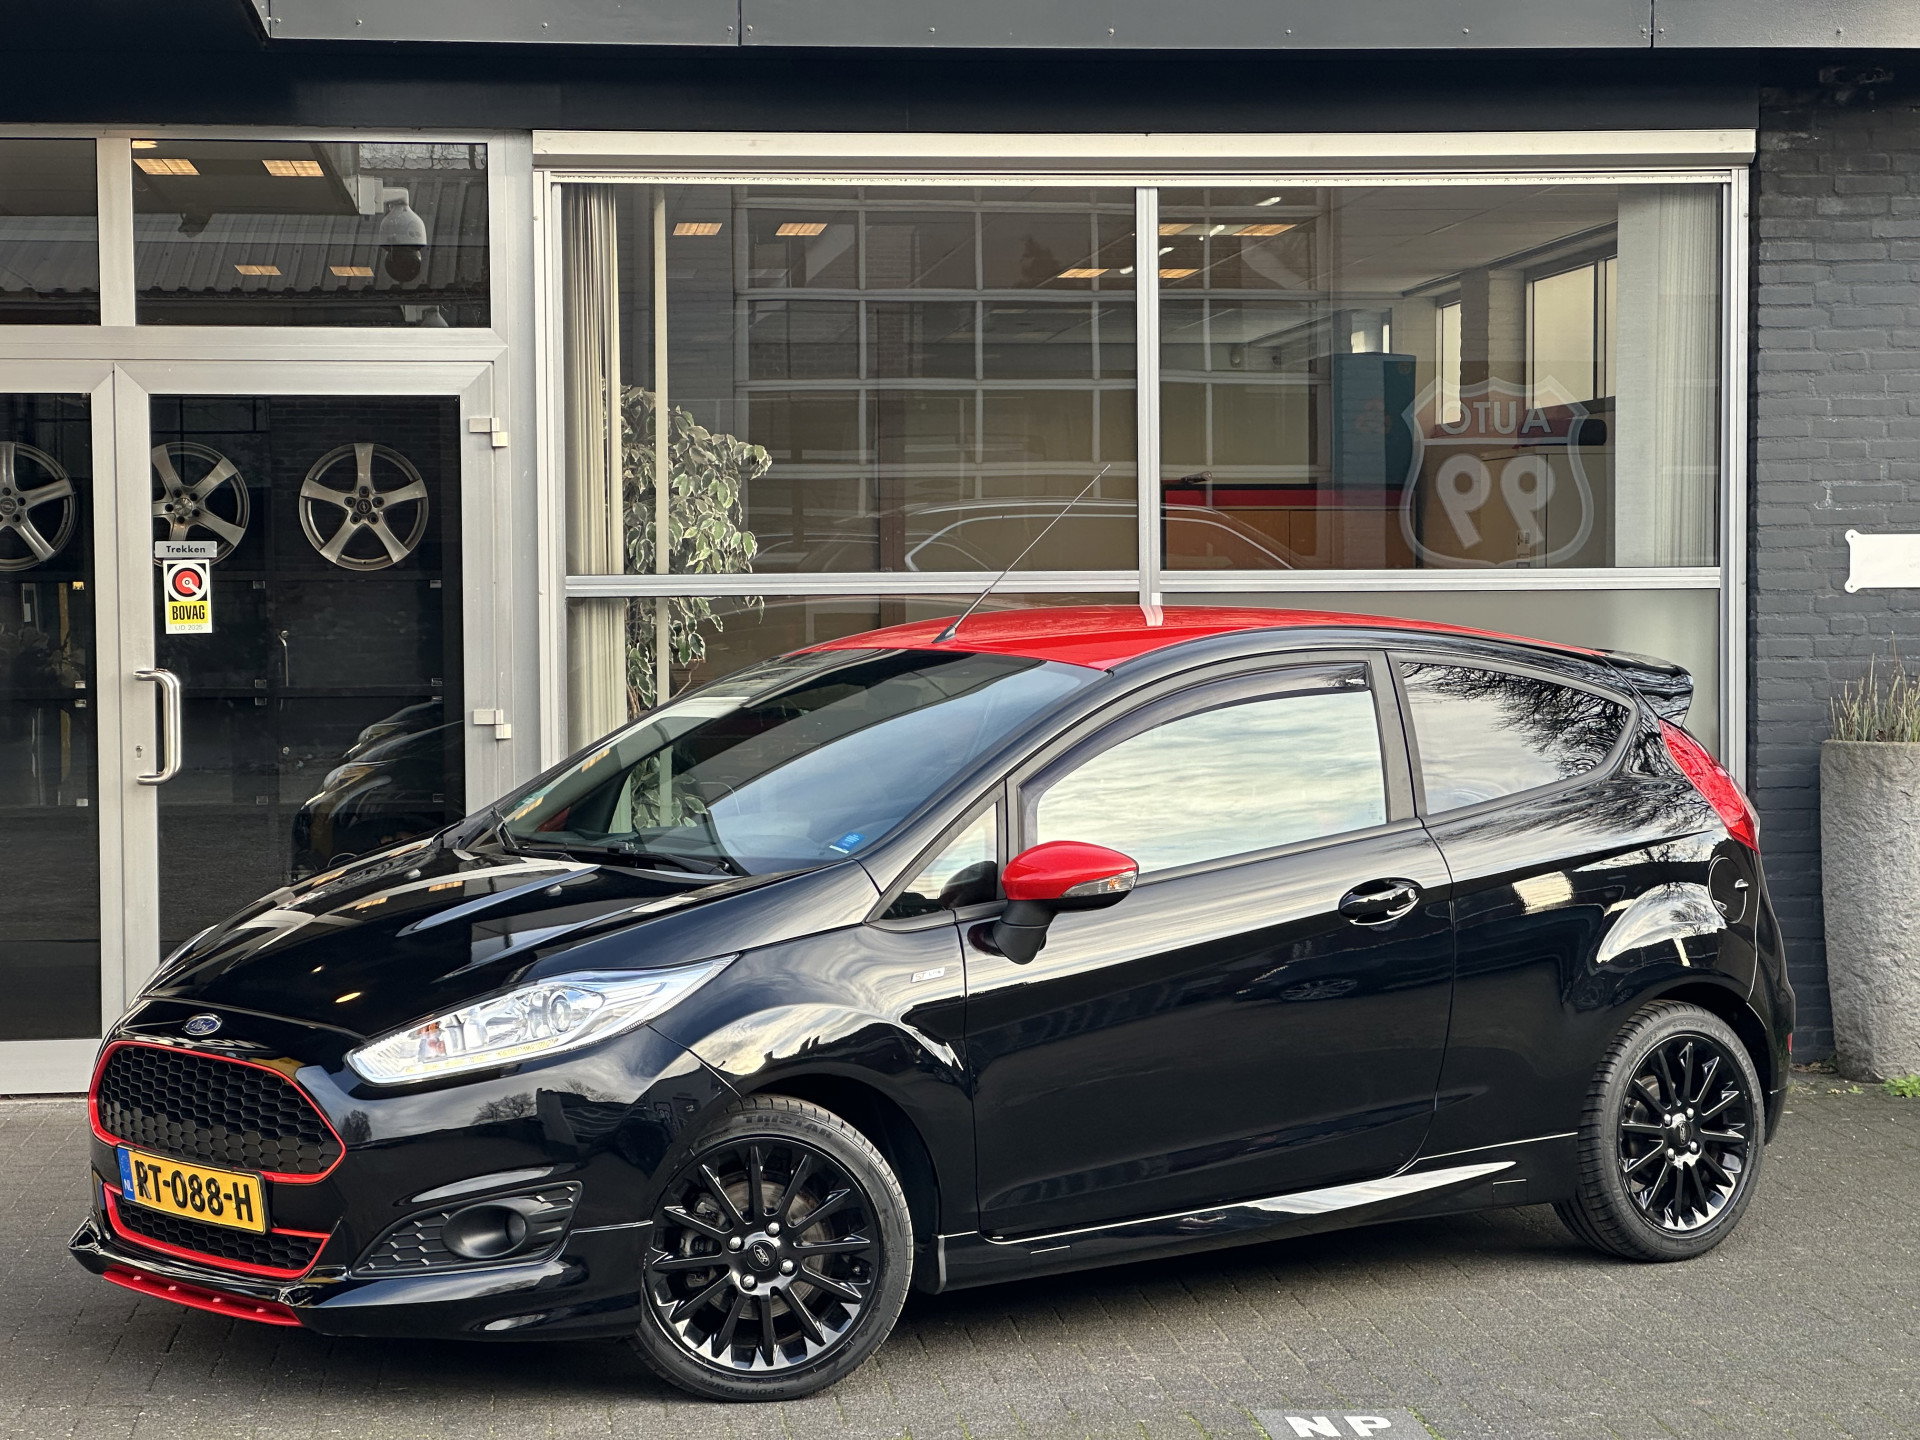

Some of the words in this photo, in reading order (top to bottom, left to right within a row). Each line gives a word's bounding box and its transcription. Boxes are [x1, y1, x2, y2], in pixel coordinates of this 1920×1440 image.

[166, 545, 206, 553] Trekken
[172, 604, 205, 620] BOVAG
[123, 1178, 134, 1192] NL
[134, 1159, 254, 1222] RT-088-H
